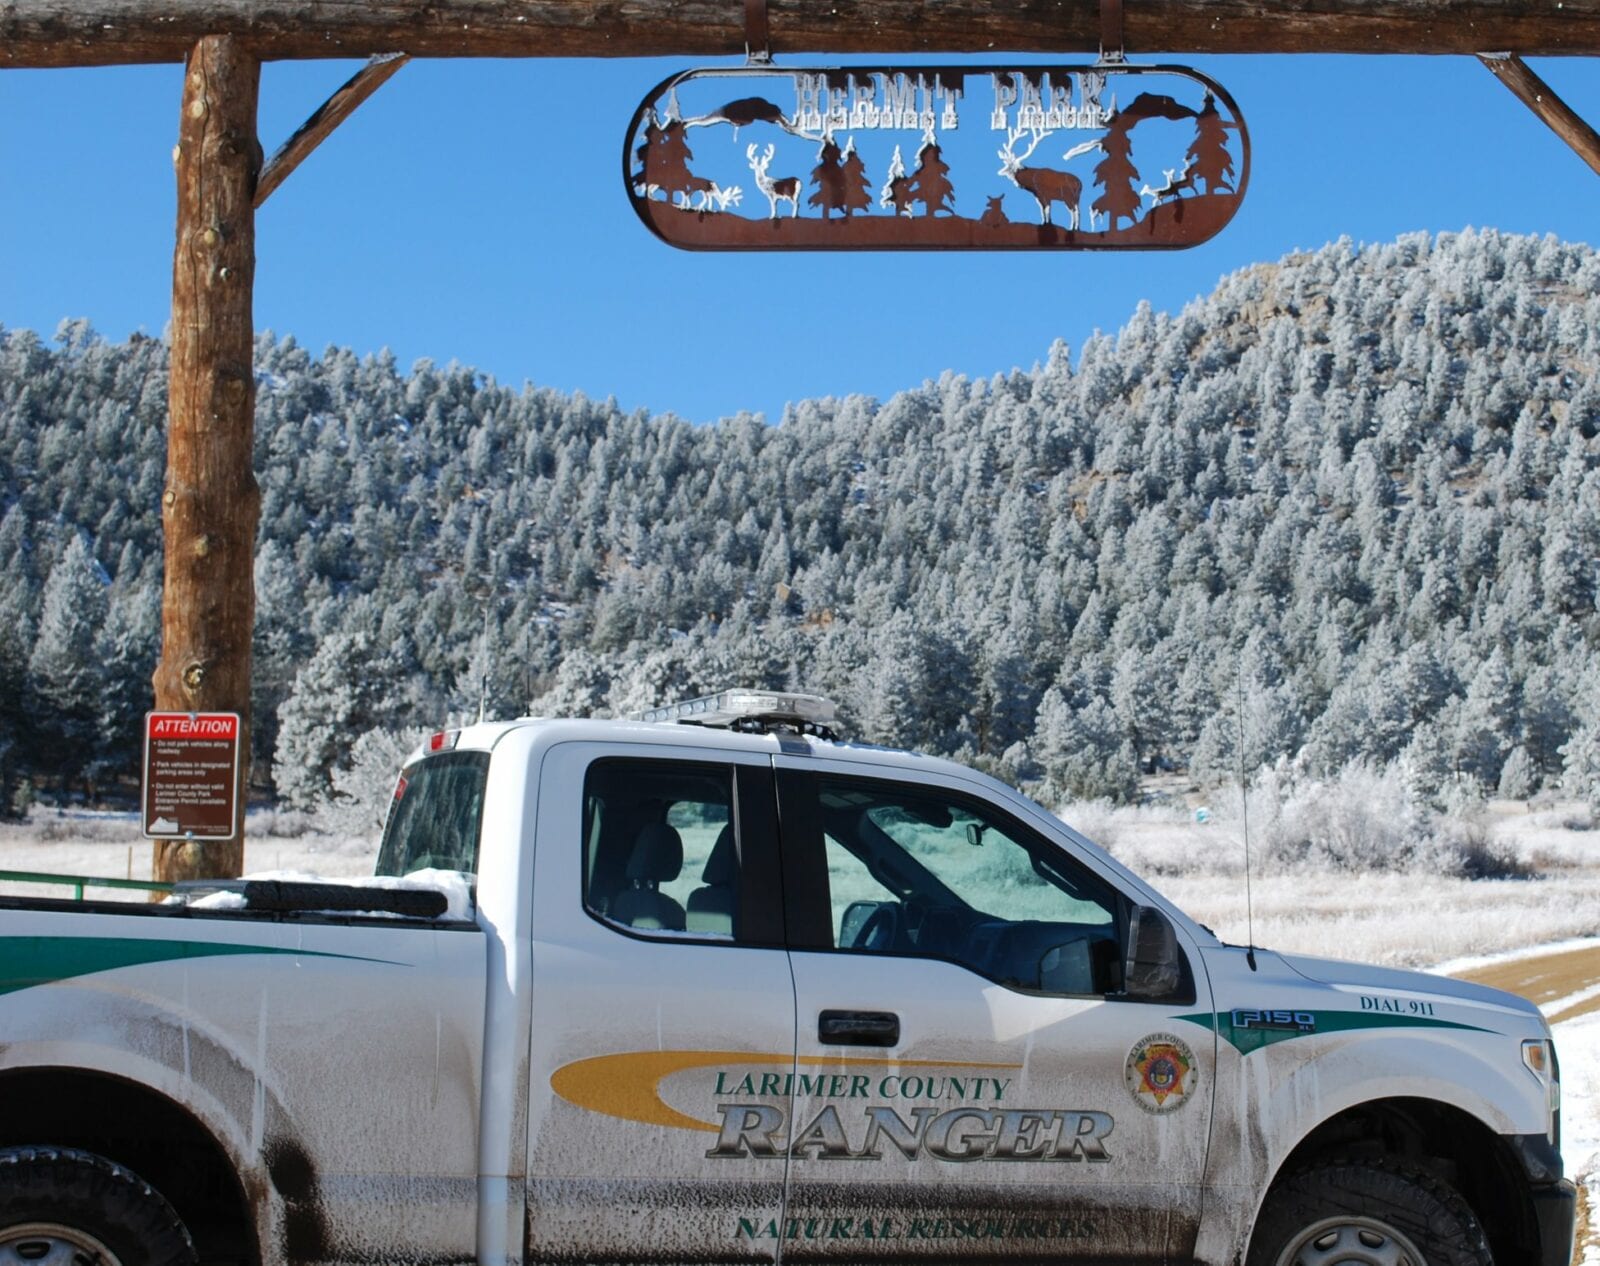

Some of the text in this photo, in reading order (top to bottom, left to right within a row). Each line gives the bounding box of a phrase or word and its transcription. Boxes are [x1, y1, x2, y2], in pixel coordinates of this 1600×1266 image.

[793, 71, 1108, 130] HERMIT PARK
[154, 719, 232, 733] ATTENTION
[176, 740, 189, 748] park
[213, 741, 230, 749] along
[177, 790, 197, 798] County
[1360, 996, 1434, 1016] DIAL 911
[1130, 1034, 1193, 1060] LARIMER COUNTY
[713, 1071, 1012, 1101] LARIMER COUNTY
[704, 1103, 1116, 1163] RANGER
[733, 1216, 1097, 1240] NATURAL RESOURCES
